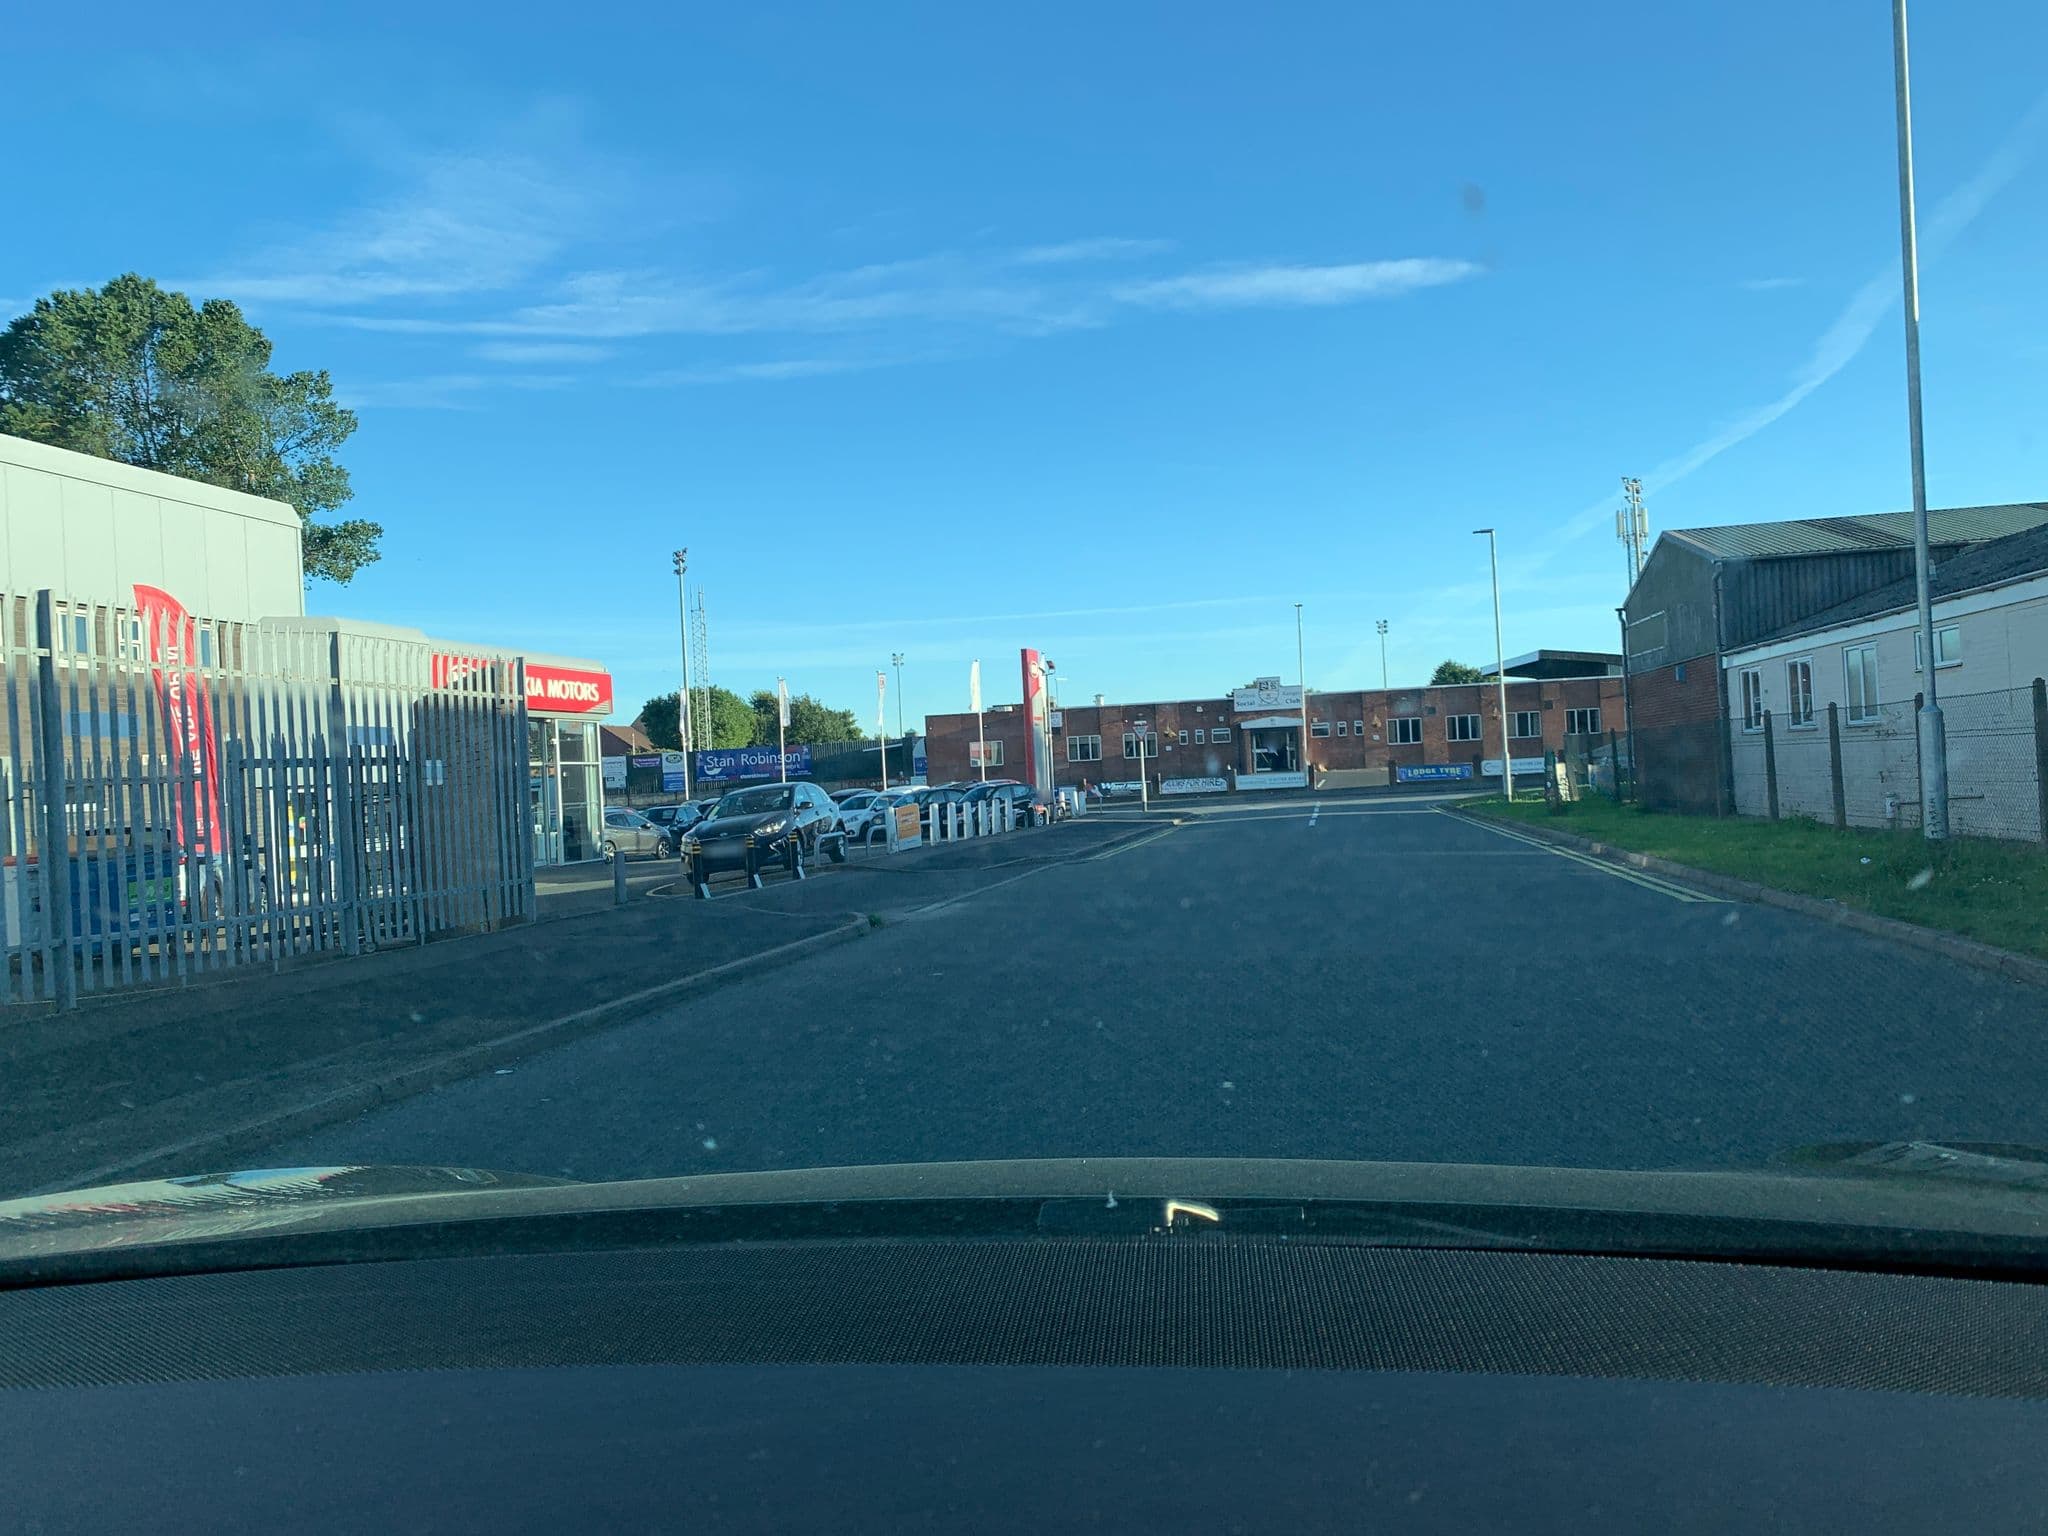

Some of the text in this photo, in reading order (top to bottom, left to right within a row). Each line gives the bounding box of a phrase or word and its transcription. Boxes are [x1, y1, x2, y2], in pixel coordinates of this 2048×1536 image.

[547, 680, 599, 702] MOTORS
[707, 753, 801, 768] Stan Robinson
[1408, 766, 1462, 776] LODGE TYRE
